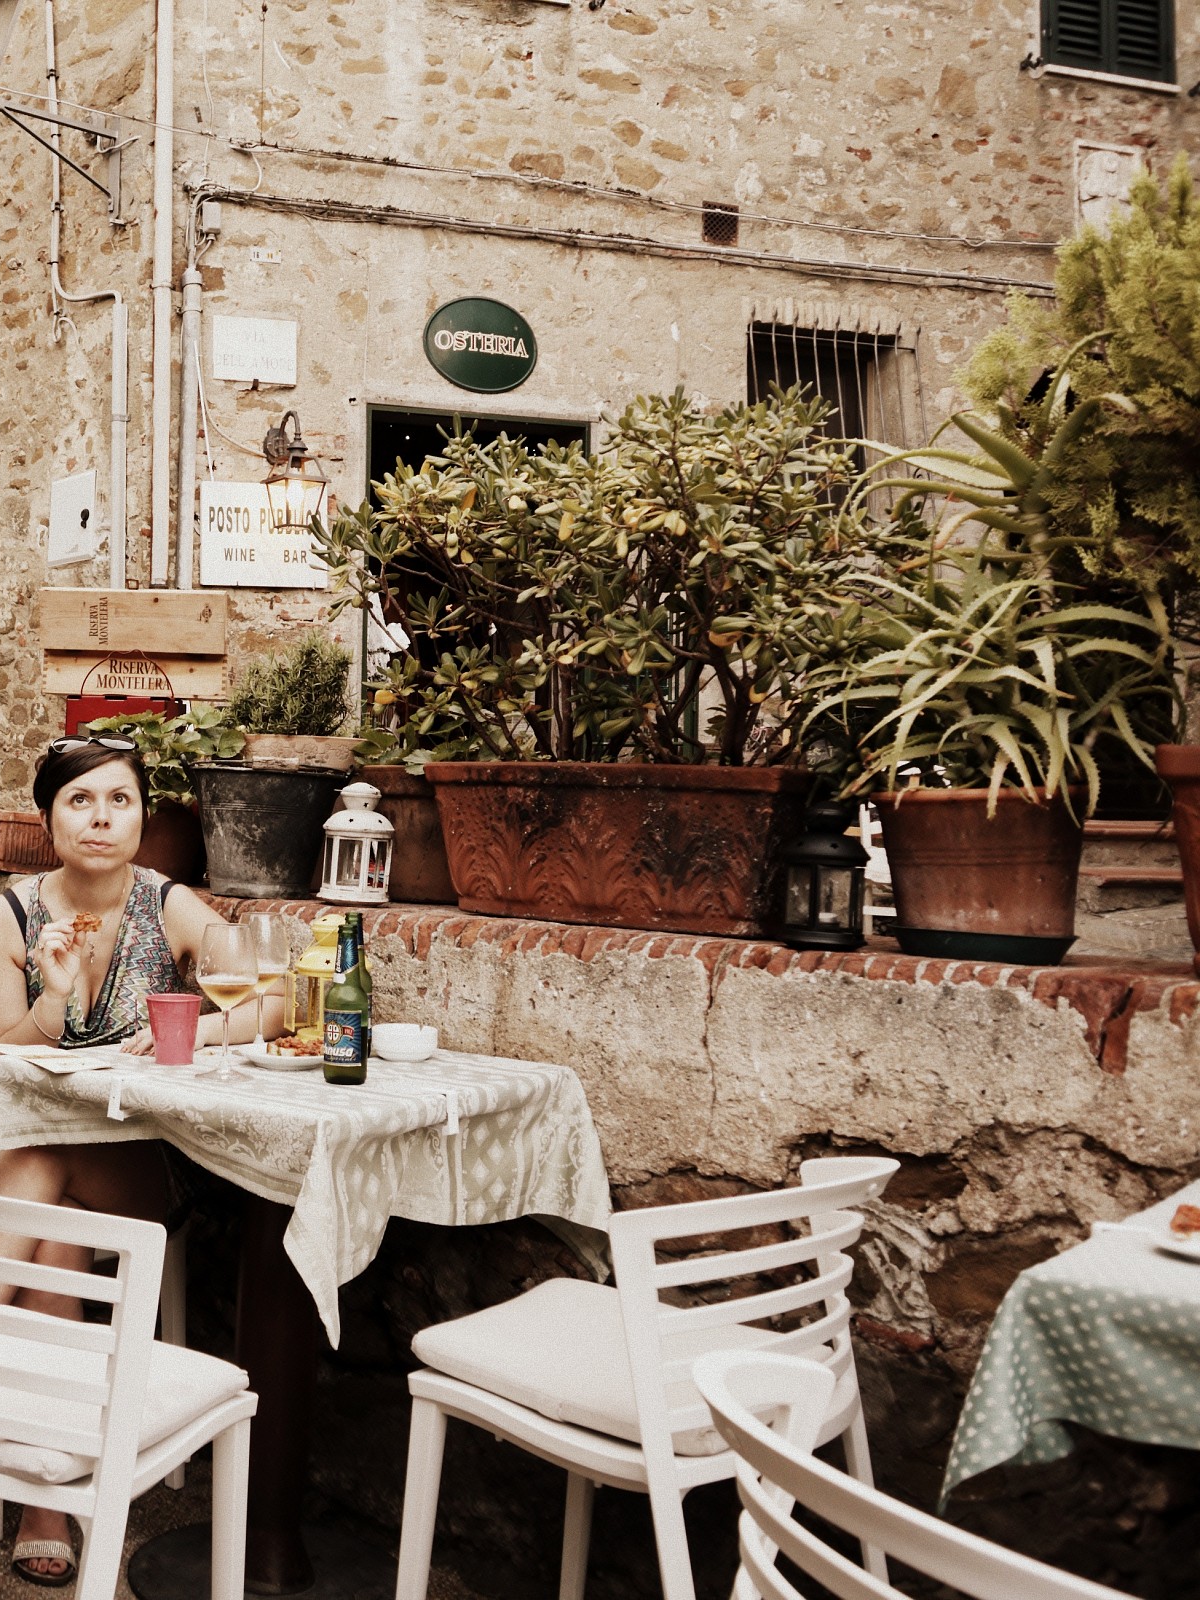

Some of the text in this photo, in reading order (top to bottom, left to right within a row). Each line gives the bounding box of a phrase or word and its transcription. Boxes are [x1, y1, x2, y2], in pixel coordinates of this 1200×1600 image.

[434, 330, 529, 358] OSTERIA
[208, 506, 250, 534] POSTO
[224, 548, 308, 564] WINE BAR
[88, 604, 99, 638] RISERVA
[99, 596, 109, 646] MONTELERA
[109, 659, 159, 675] RISERVA
[96, 674, 171, 691] MONTELERA
